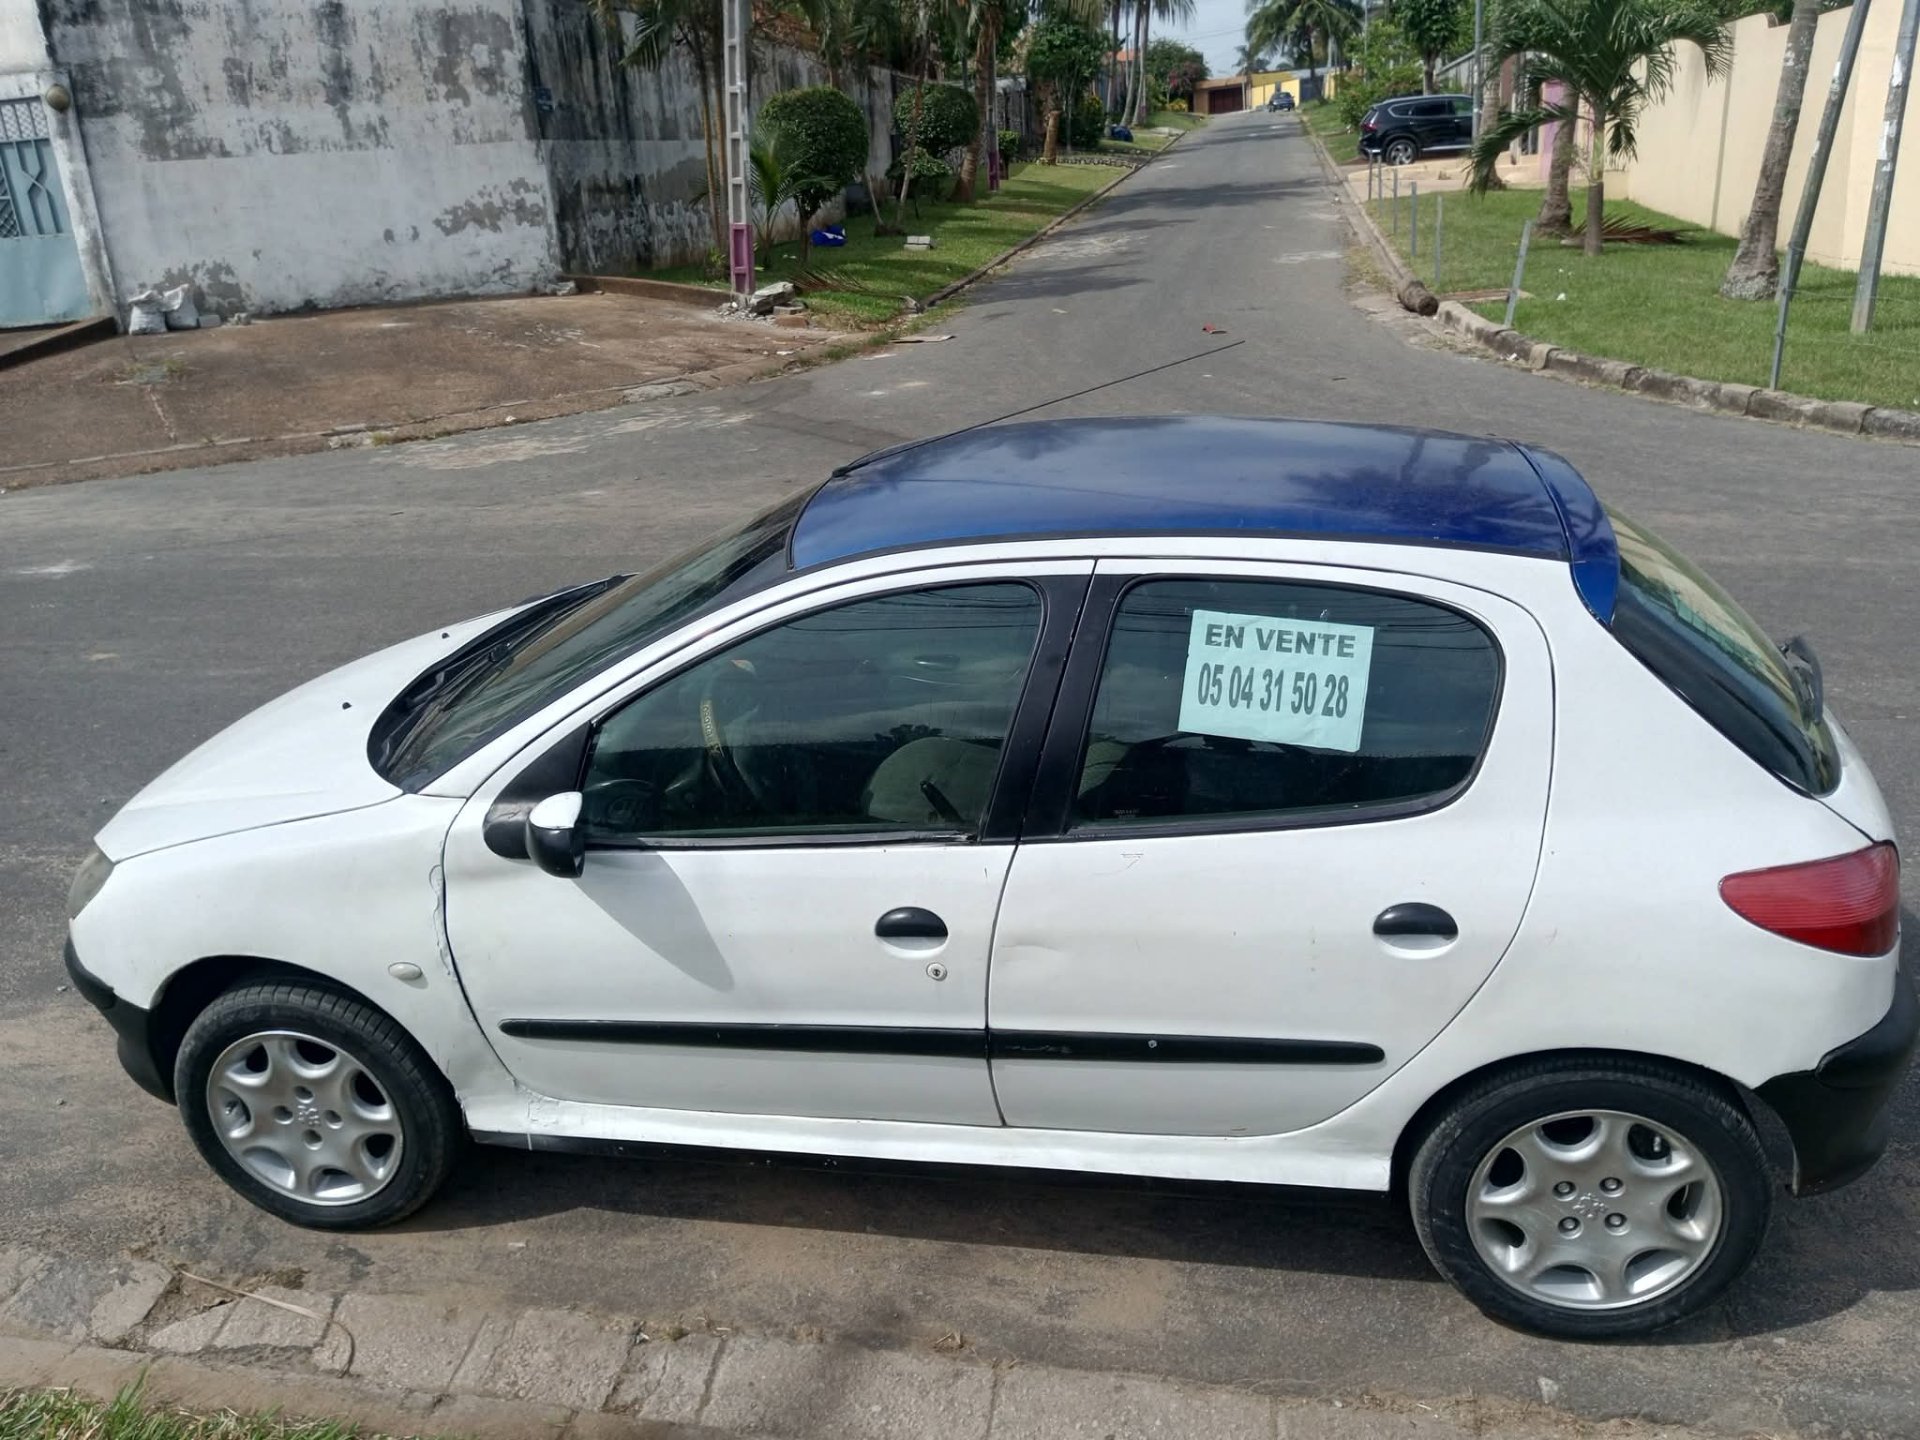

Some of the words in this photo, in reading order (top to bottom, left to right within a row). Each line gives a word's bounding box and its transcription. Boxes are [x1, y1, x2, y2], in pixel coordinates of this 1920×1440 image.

[1205, 624, 1245, 648] EN
[1256, 628, 1356, 658] VENTE
[1198, 663, 1224, 706] 05
[1229, 666, 1254, 709] 04
[1260, 669, 1284, 712] 31
[1291, 672, 1317, 715] 50
[1321, 674, 1349, 718] 28
